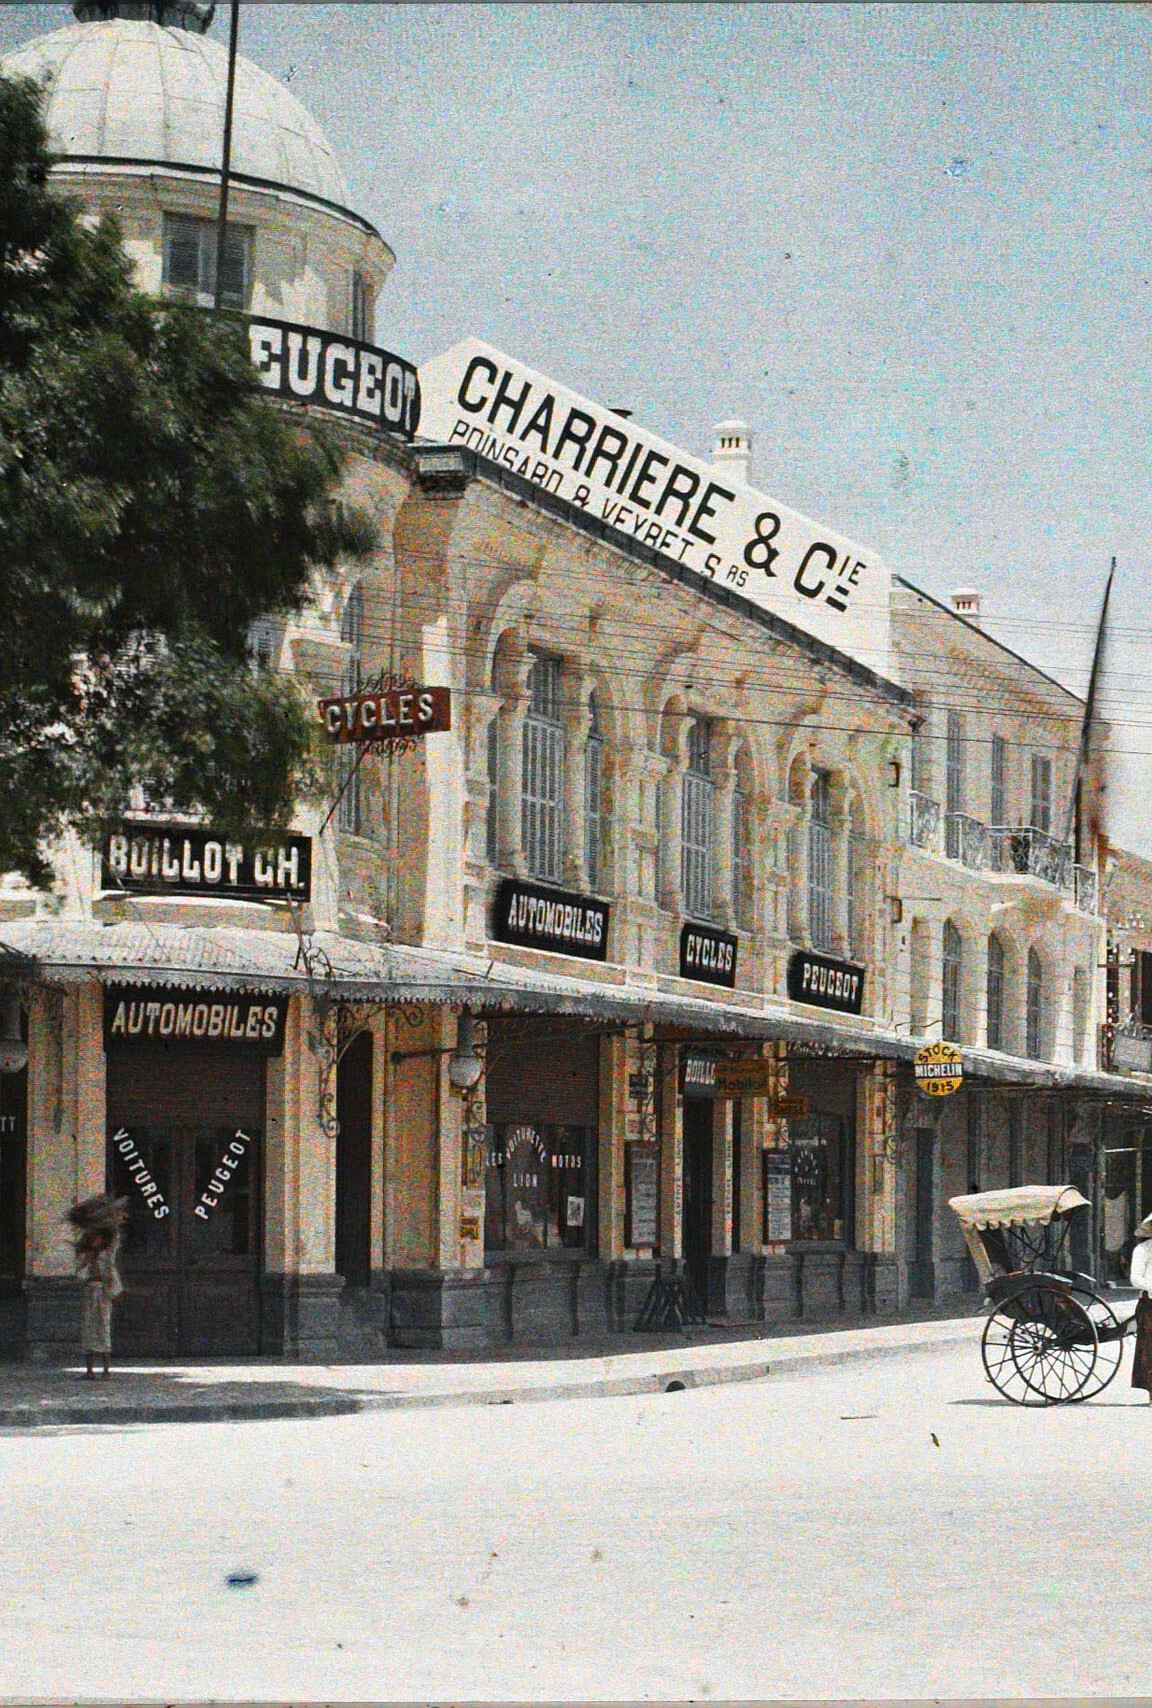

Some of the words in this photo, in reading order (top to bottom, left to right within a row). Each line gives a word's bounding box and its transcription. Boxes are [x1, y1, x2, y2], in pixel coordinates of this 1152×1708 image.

[248, 323, 418, 432] EUGEOT
[457, 355, 736, 546] CHARRIERE
[743, 511, 782, 578] &
[326, 693, 434, 734] CYCLES
[507, 892, 604, 943] AUTOMOBILES
[686, 933, 734, 972] CYCLES
[801, 962, 859, 1001] PEUGEOT
[111, 1001, 279, 1038] AUTOMOBILES
[914, 1062, 963, 1078] MICHELIN
[918, 1044, 958, 1062] STOCK
[927, 1080, 955, 1093] 1915
[112, 1127, 171, 1220] VOITURES
[194, 1128, 252, 1220] PEUGEOT
